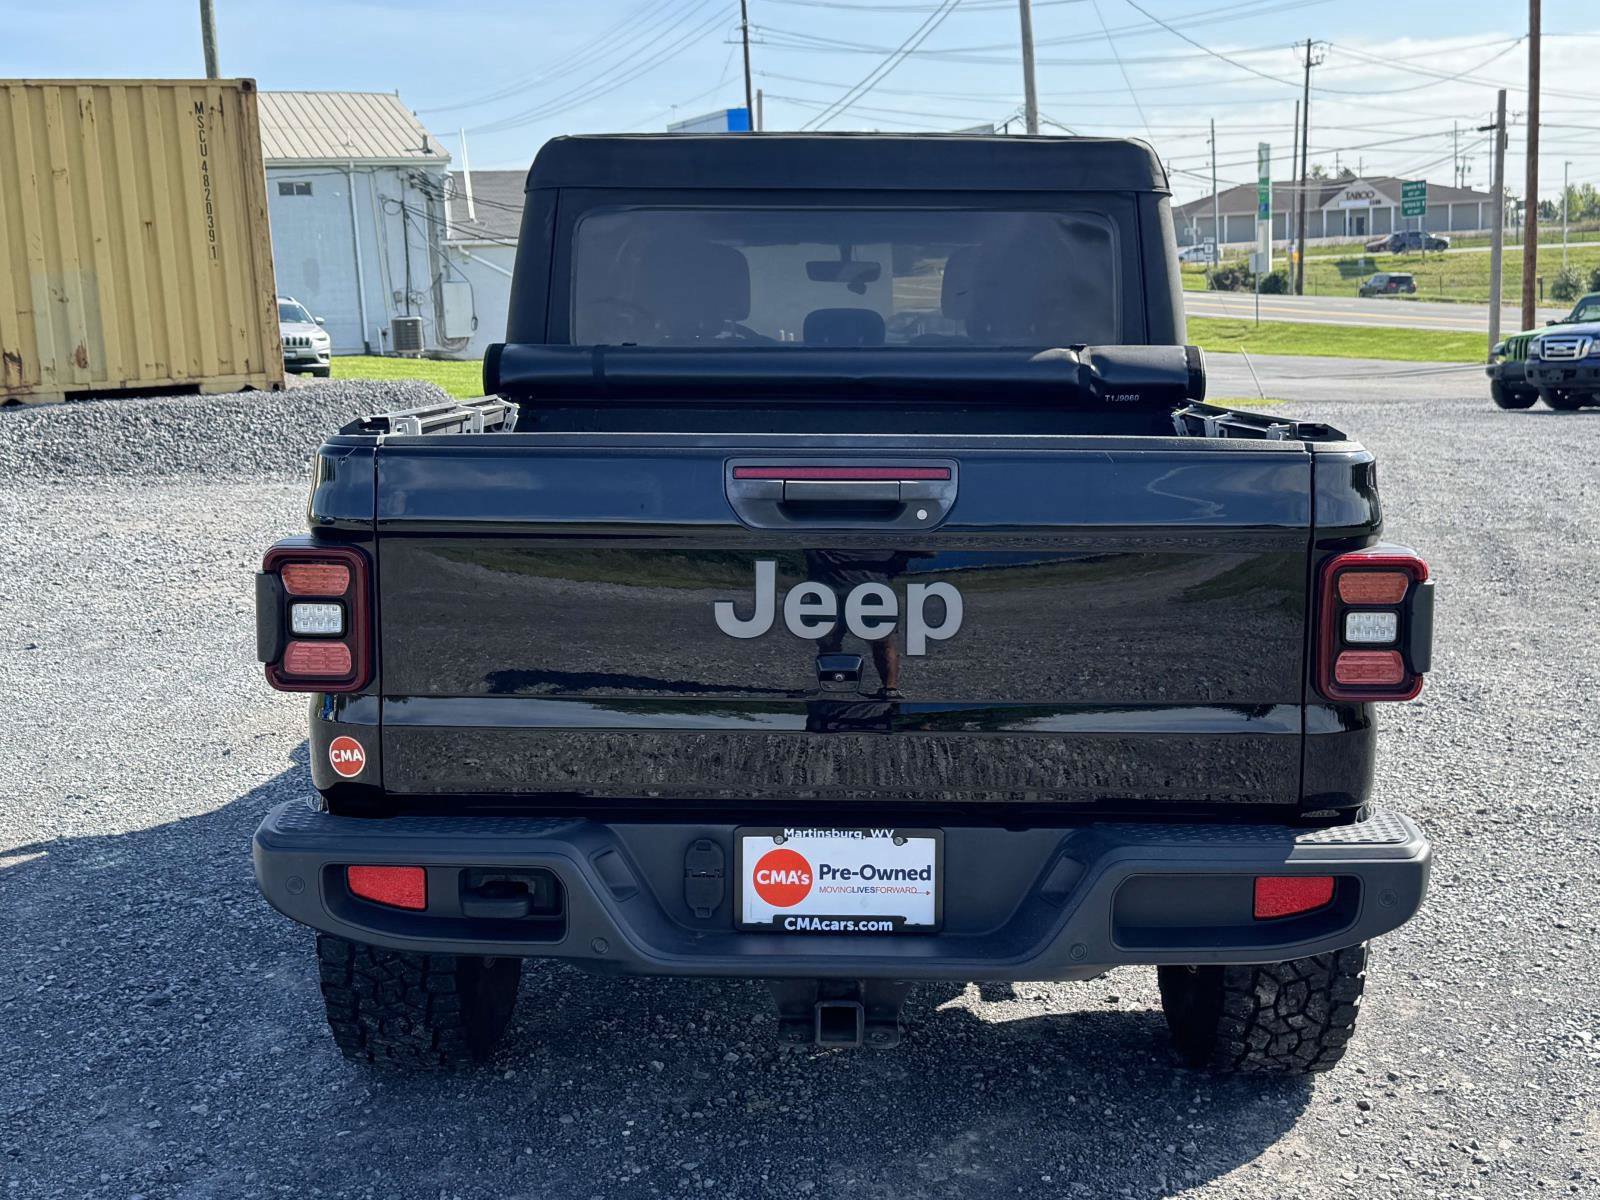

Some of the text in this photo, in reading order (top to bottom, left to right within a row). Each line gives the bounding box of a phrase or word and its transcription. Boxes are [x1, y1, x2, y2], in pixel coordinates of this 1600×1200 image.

[714, 560, 964, 656] Jeep
[331, 748, 363, 763] CMA
[783, 828, 895, 840] Martinsburg, WV
[756, 868, 810, 886] CMA's
[819, 863, 932, 882] Pre-Owned
[783, 917, 893, 931] CMAcars.com
